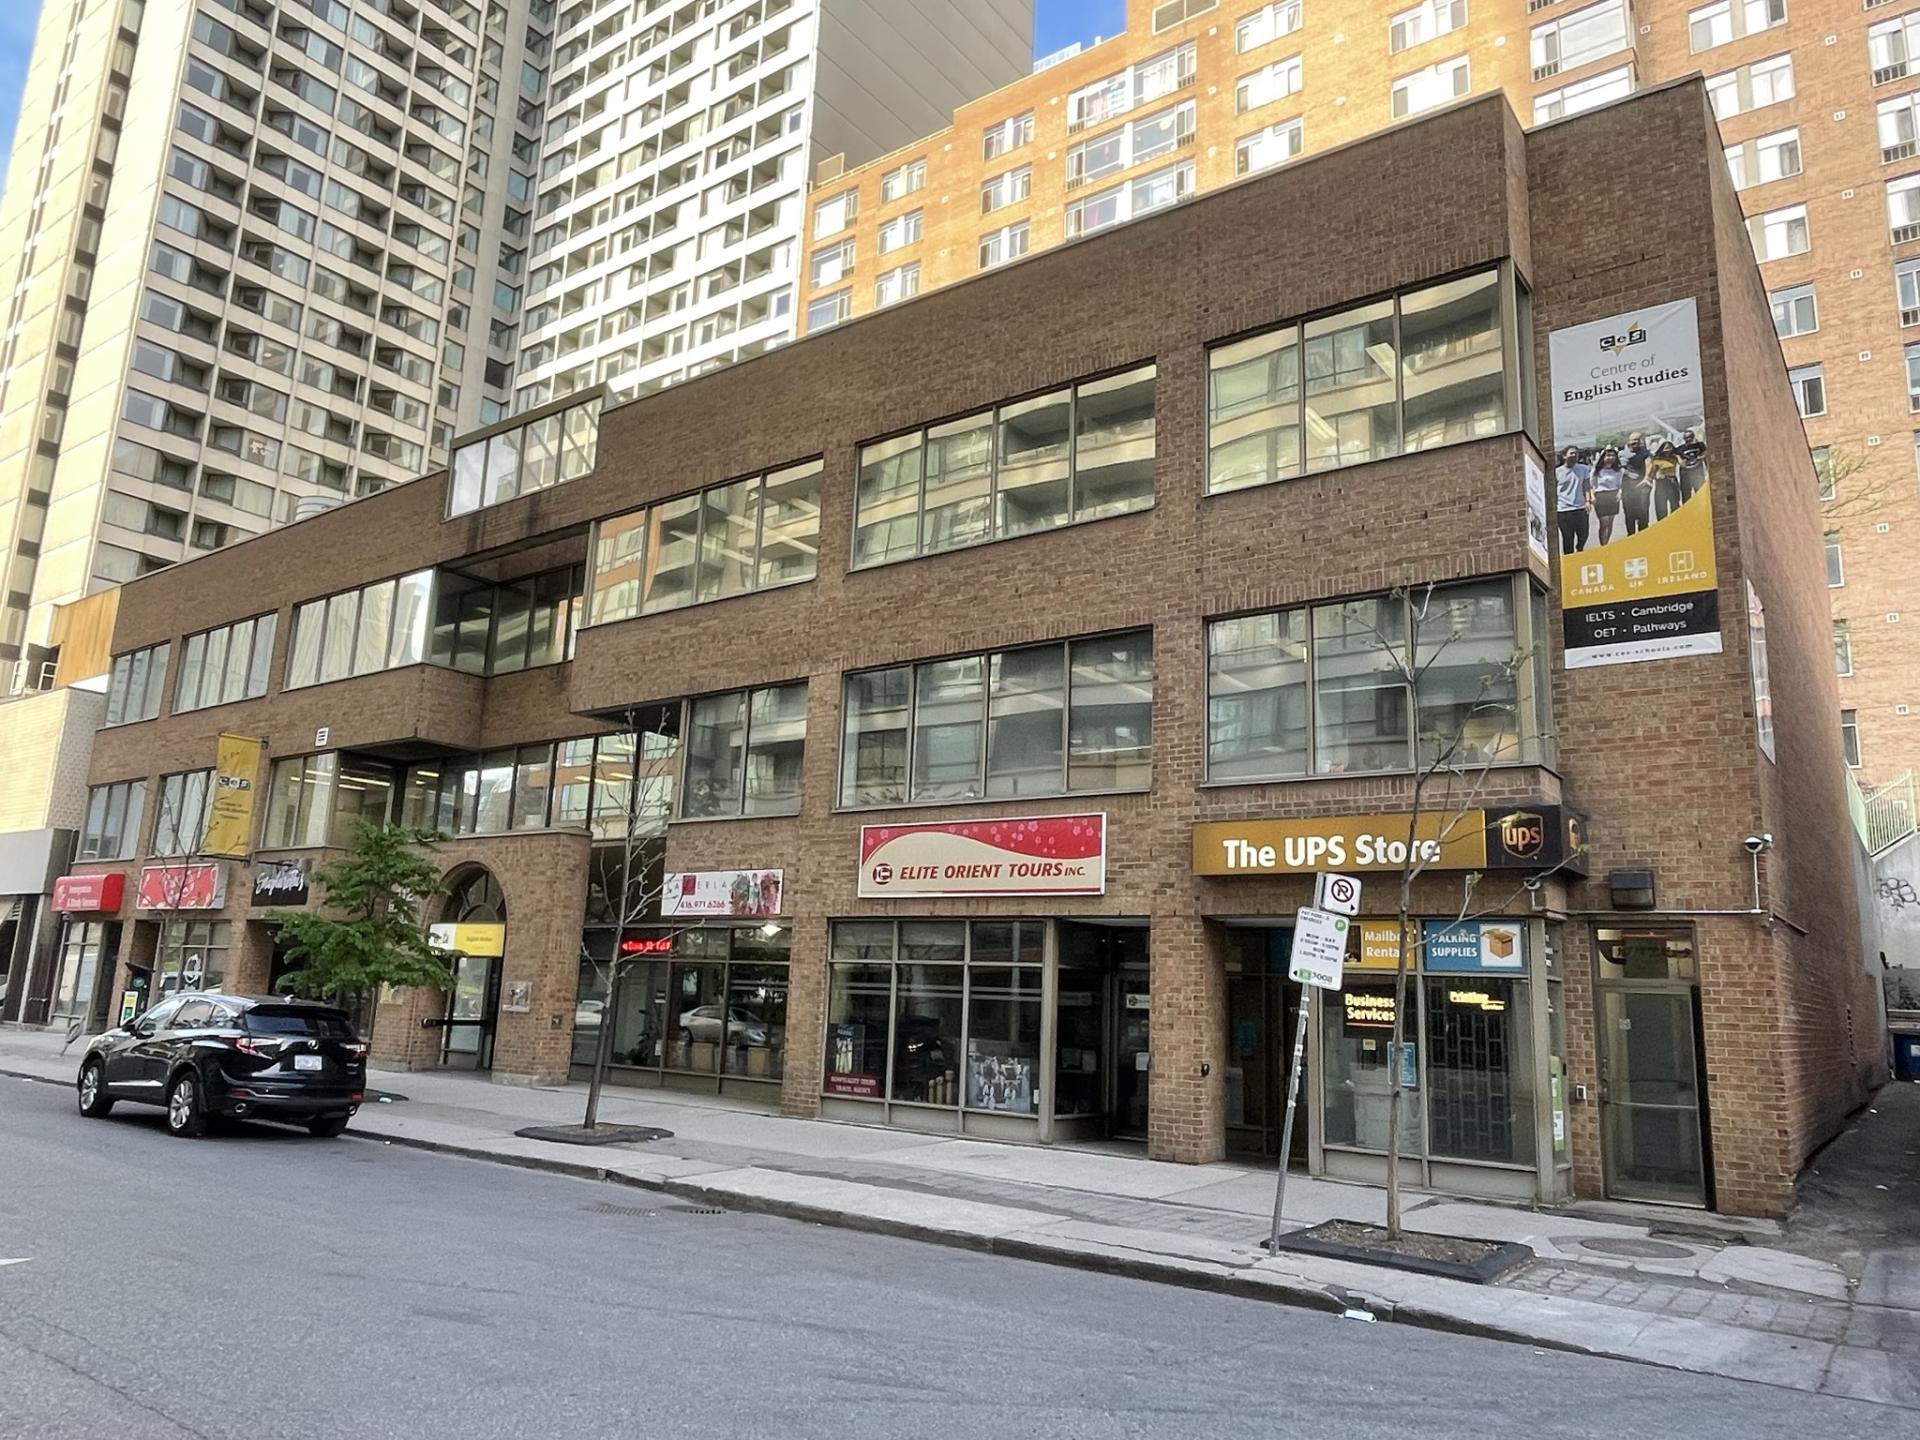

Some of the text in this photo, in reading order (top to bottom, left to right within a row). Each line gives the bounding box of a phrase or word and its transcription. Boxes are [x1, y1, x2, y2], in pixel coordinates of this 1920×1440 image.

[1590, 354, 1657, 379] Centre of
[1564, 367, 1689, 402] English Studies
[1570, 571, 1708, 597] CANADA UK IRELAND
[1585, 602, 1694, 623] IELTS Cambridge
[1594, 620, 1687, 639] OET Pathways
[1505, 827, 1541, 852] ups
[1222, 834, 1441, 869] The UPS Store
[899, 866, 939, 881] ELITE
[944, 864, 1003, 879] ORIENT
[1009, 862, 1063, 877] TOURS
[1366, 947, 1410, 958] Renta
[1431, 947, 1478, 957] SUPPLIES
[1345, 994, 1395, 1008] Business
[1347, 1007, 1396, 1021] Services
